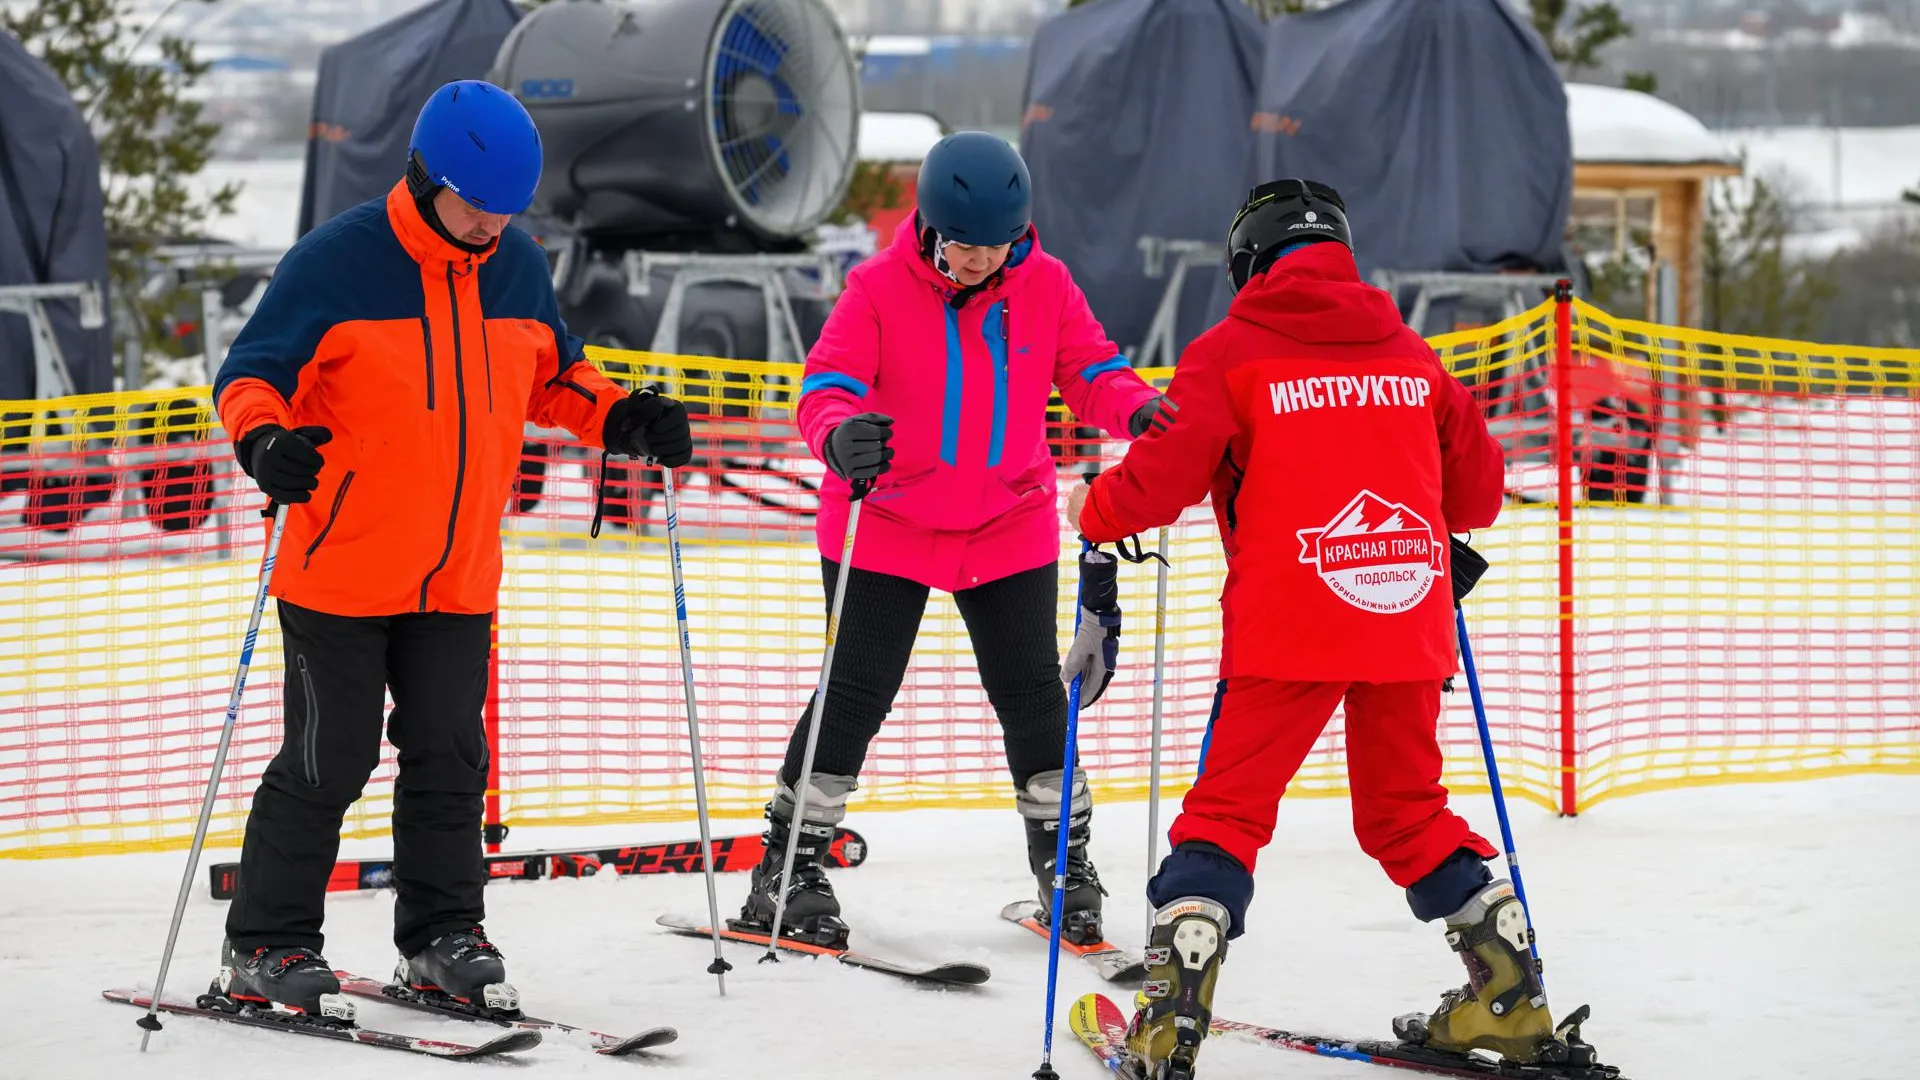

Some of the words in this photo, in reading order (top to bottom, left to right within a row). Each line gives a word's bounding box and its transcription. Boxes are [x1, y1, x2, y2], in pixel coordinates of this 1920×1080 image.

[440, 175, 460, 193] Prime
[1287, 223, 1335, 231] ALPINA
[1269, 375, 1431, 415] ИНСТРУКТОР
[1325, 540, 1387, 563] КРАСНАЯ
[1391, 538, 1429, 556] ГОРКА
[1355, 570, 1417, 586] ПОДОЛЬСК
[1328, 576, 1398, 611] ГОРНОЛЫЖНЫЙ
[1399, 575, 1431, 608] КОМПЛЕКС
